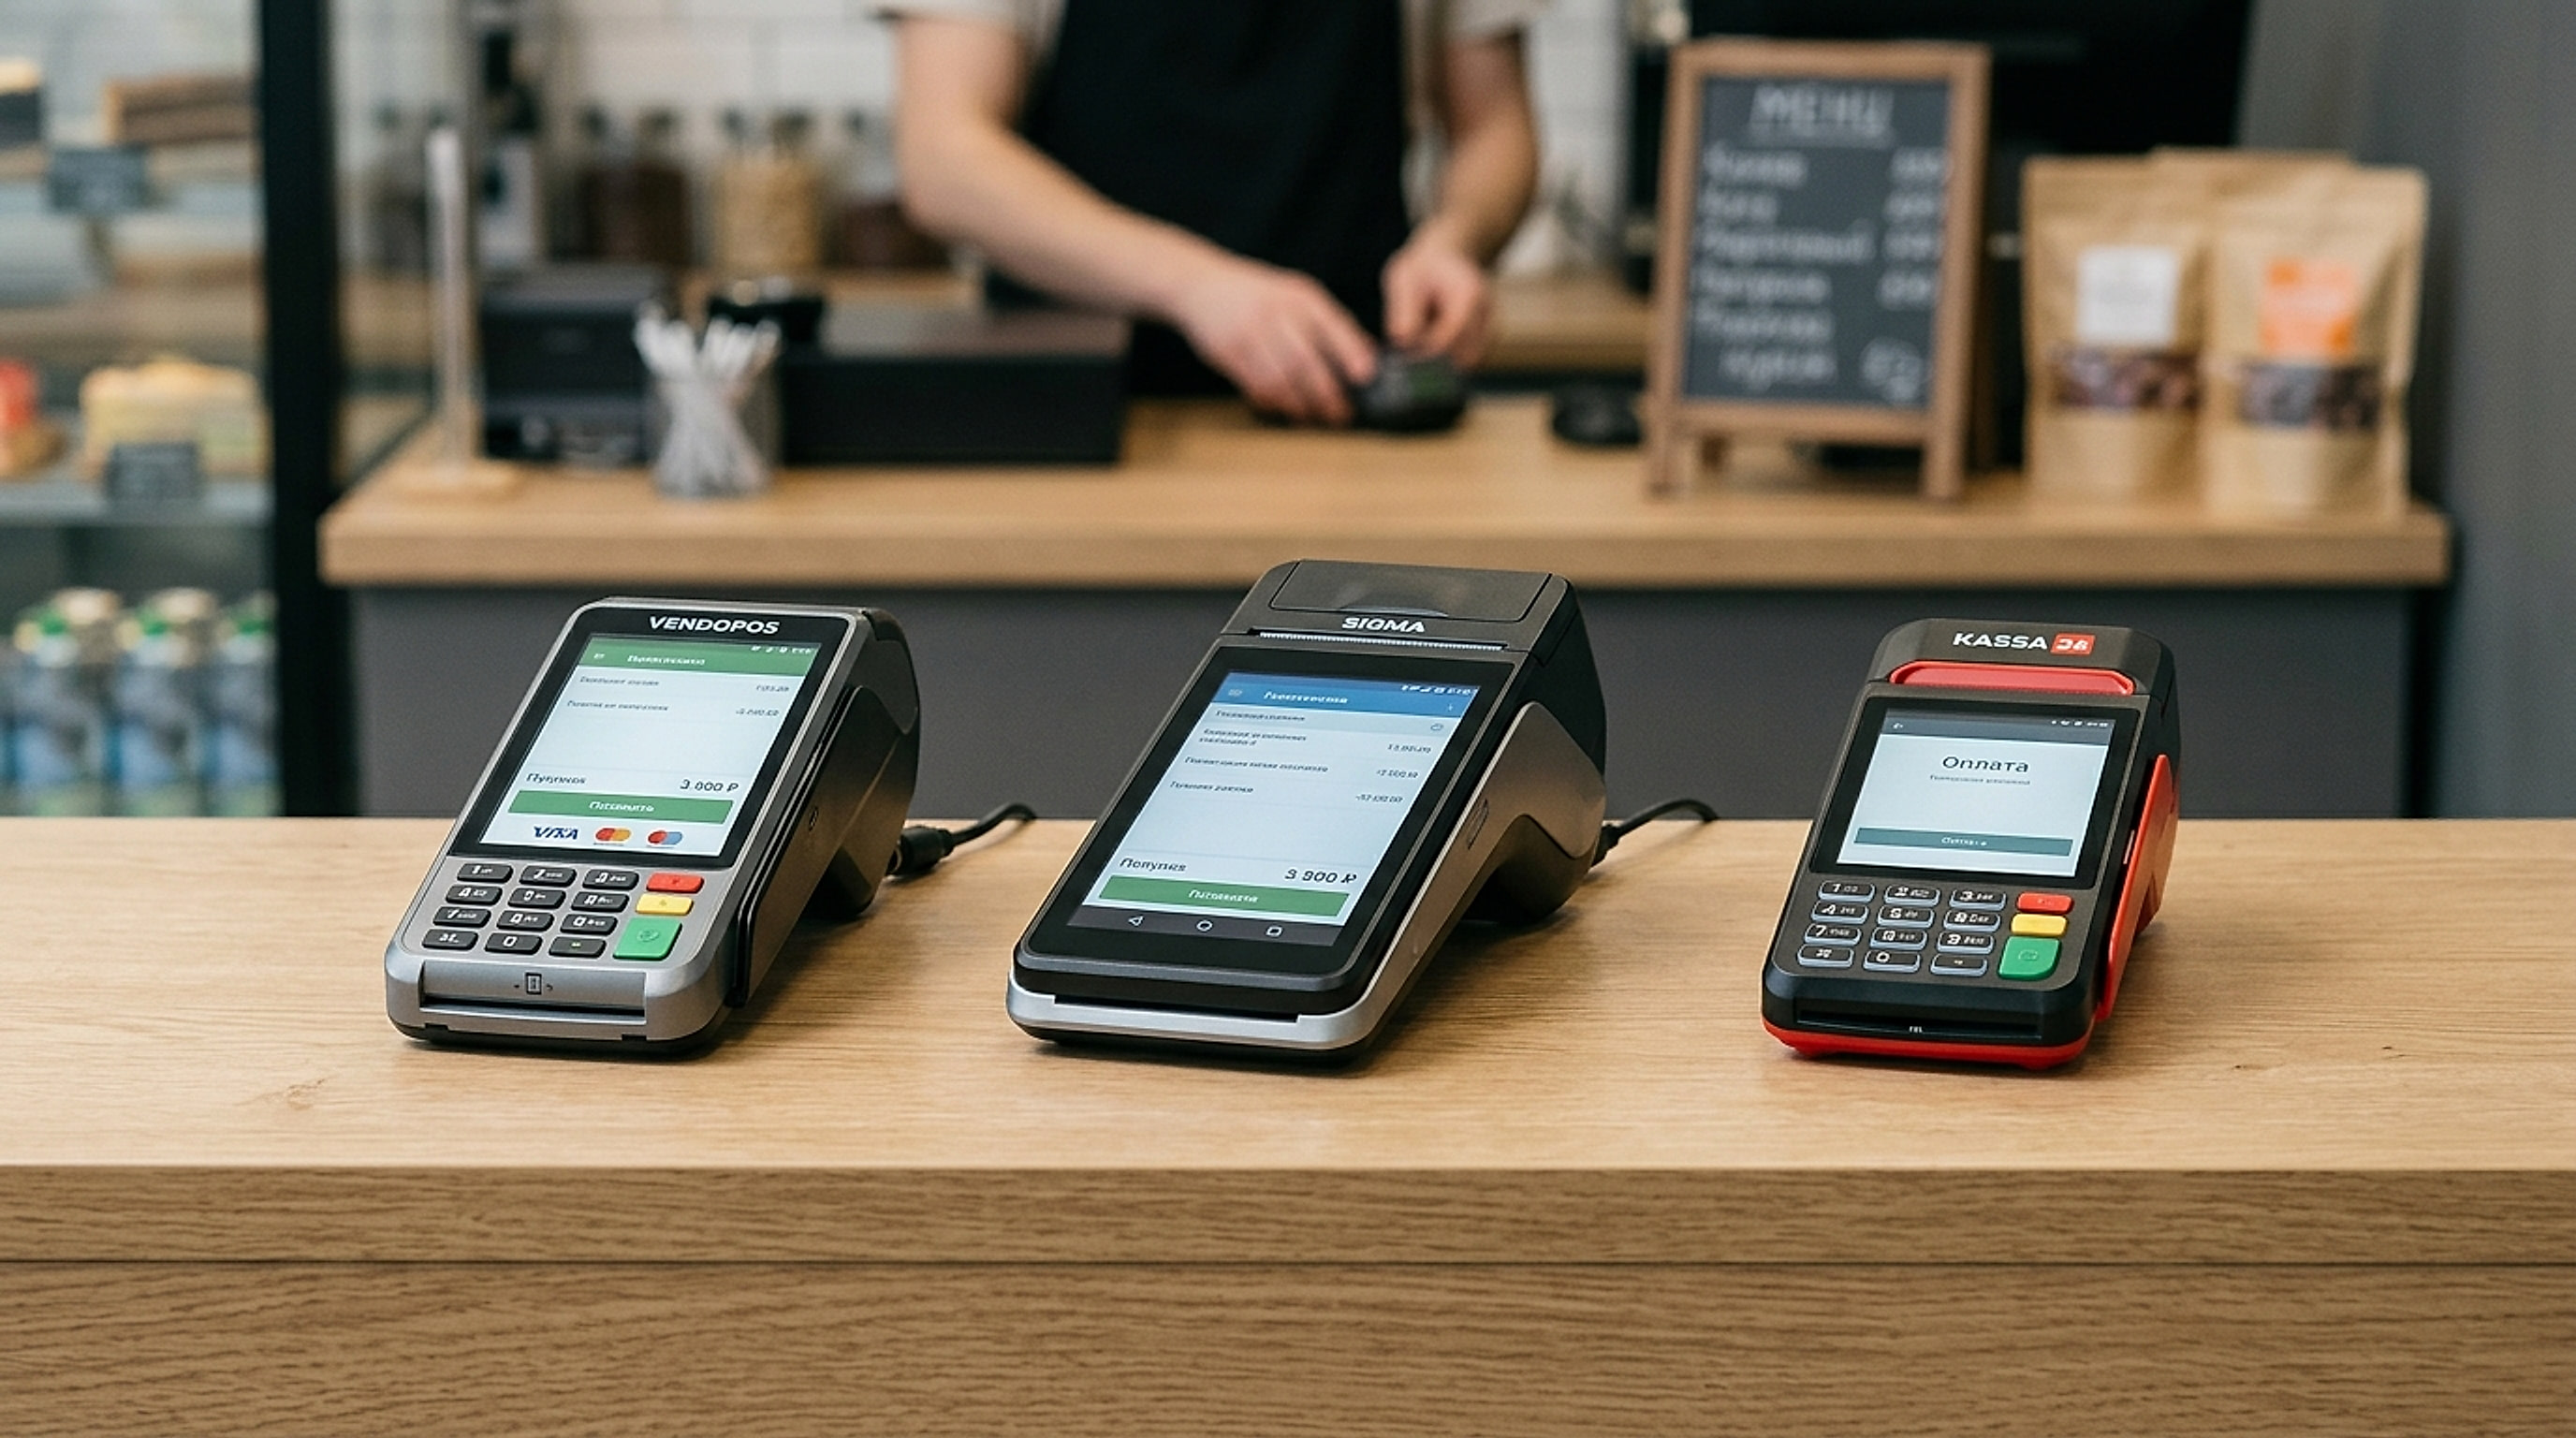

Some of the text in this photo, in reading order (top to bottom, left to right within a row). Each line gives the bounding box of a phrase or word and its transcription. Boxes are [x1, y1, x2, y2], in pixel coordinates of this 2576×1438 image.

[649, 616, 780, 635] VENDOPOS
[1341, 617, 1426, 633] SIGMA
[1953, 633, 2048, 650] KASSA
[1942, 756, 2029, 773] Оплата
